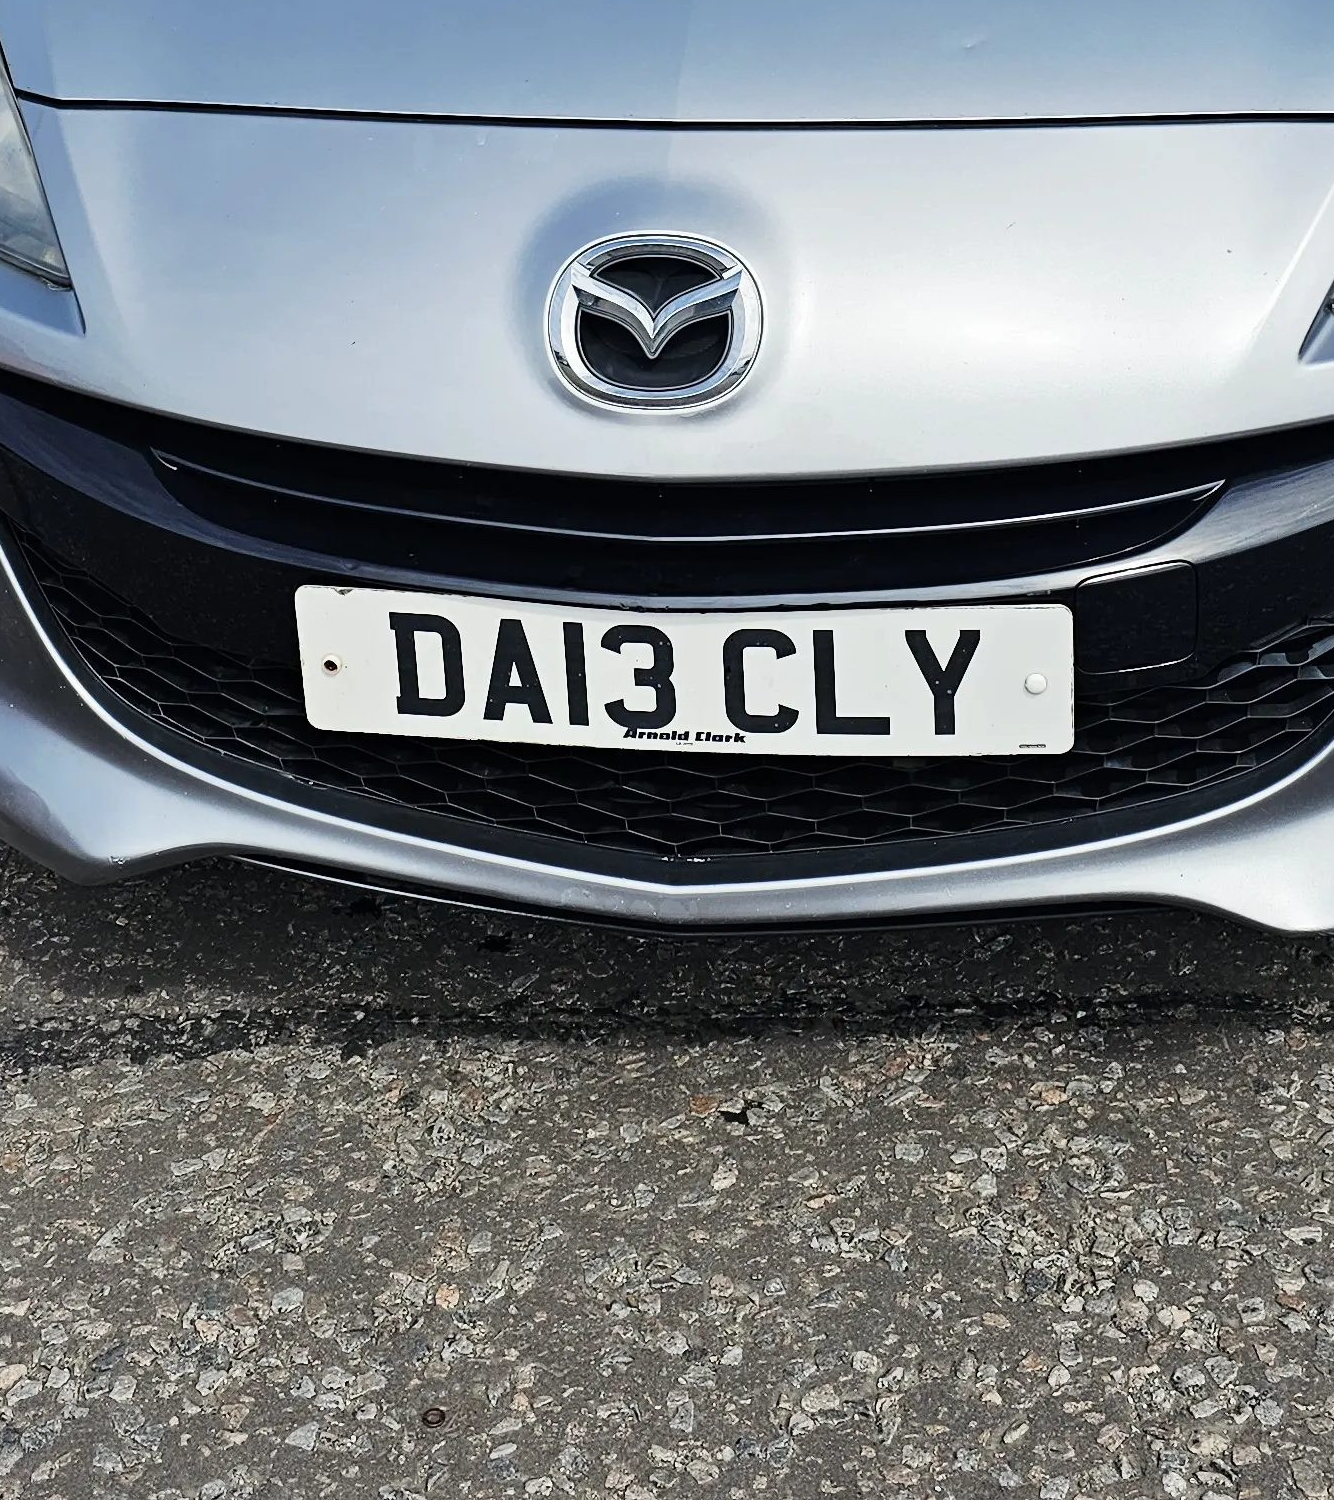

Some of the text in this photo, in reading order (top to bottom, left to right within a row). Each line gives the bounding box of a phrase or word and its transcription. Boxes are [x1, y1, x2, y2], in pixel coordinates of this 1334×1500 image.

[388, 611, 981, 735] DA13 CLY
[623, 728, 746, 743] Arnold Clark
